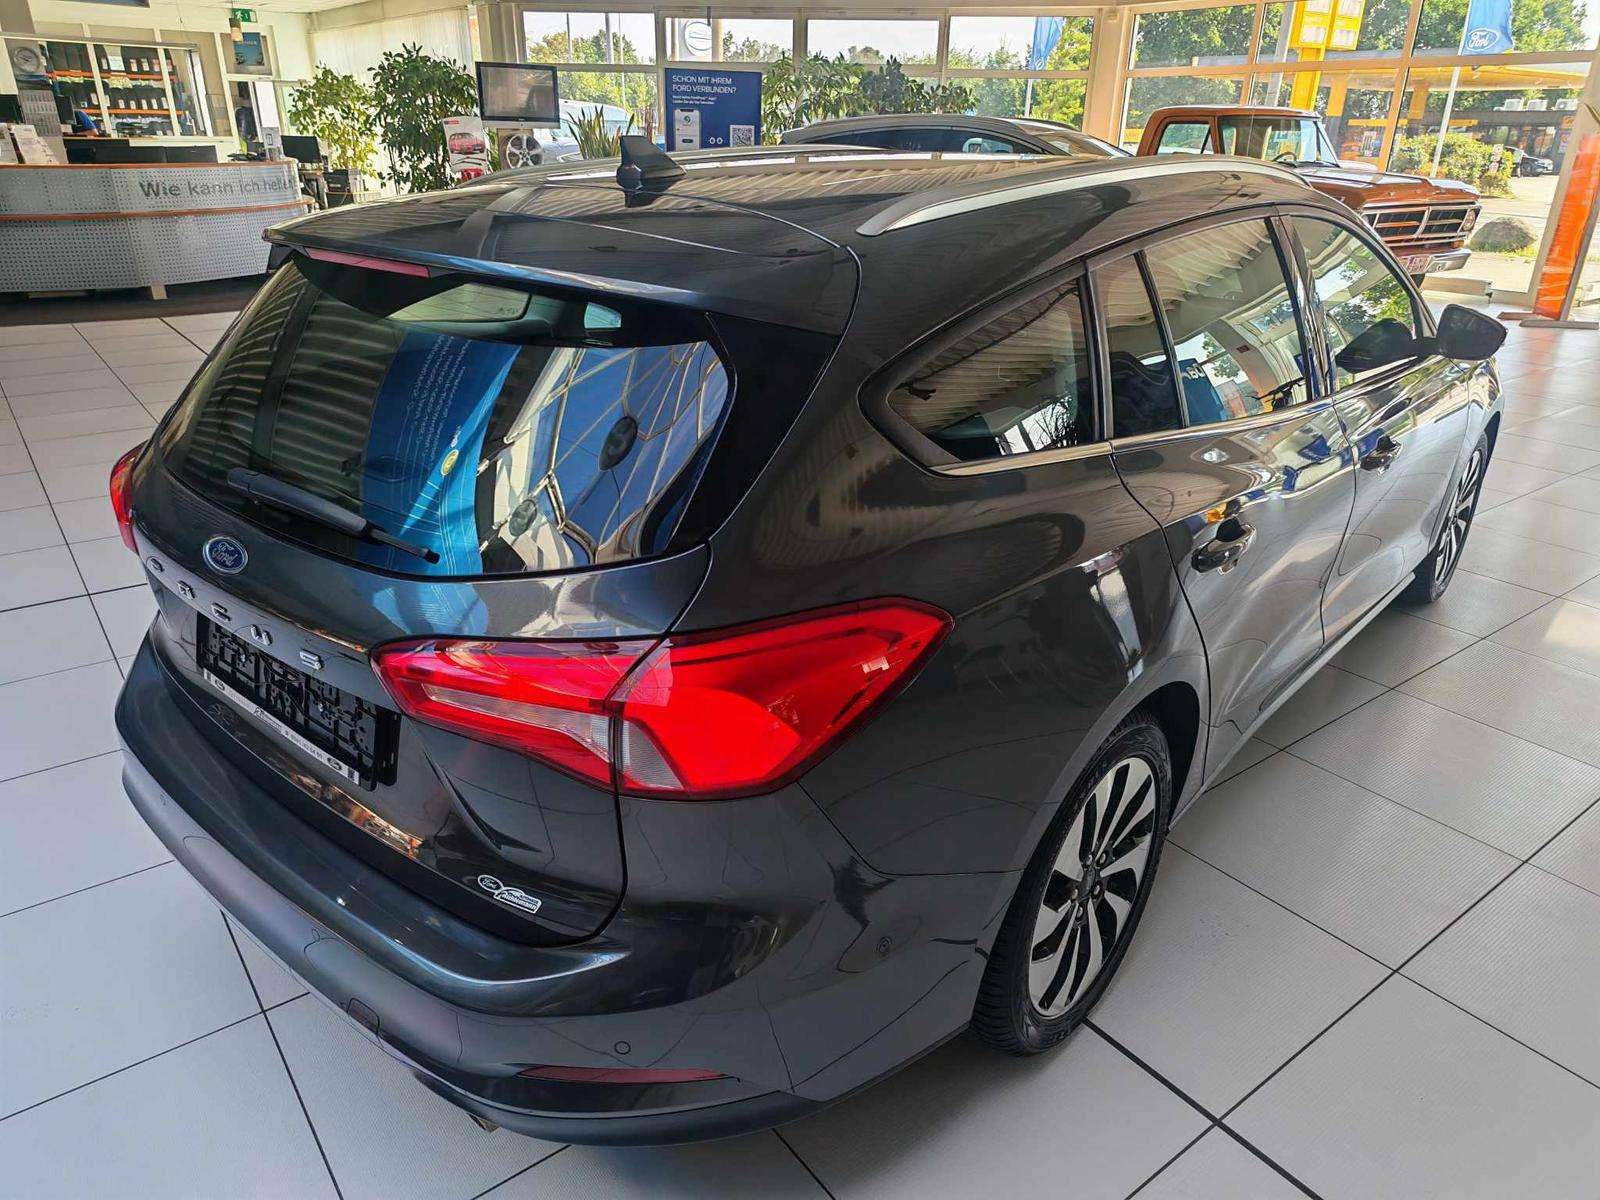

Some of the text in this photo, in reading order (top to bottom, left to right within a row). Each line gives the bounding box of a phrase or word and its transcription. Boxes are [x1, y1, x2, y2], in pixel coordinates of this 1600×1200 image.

[1468, 31, 1490, 48] Ford
[672, 75, 697, 83] SCHON
[698, 76, 710, 84] MIT
[672, 84, 737, 94] FORD VERBUNDEN?
[139, 180, 181, 197] Wie
[188, 180, 234, 196] kann
